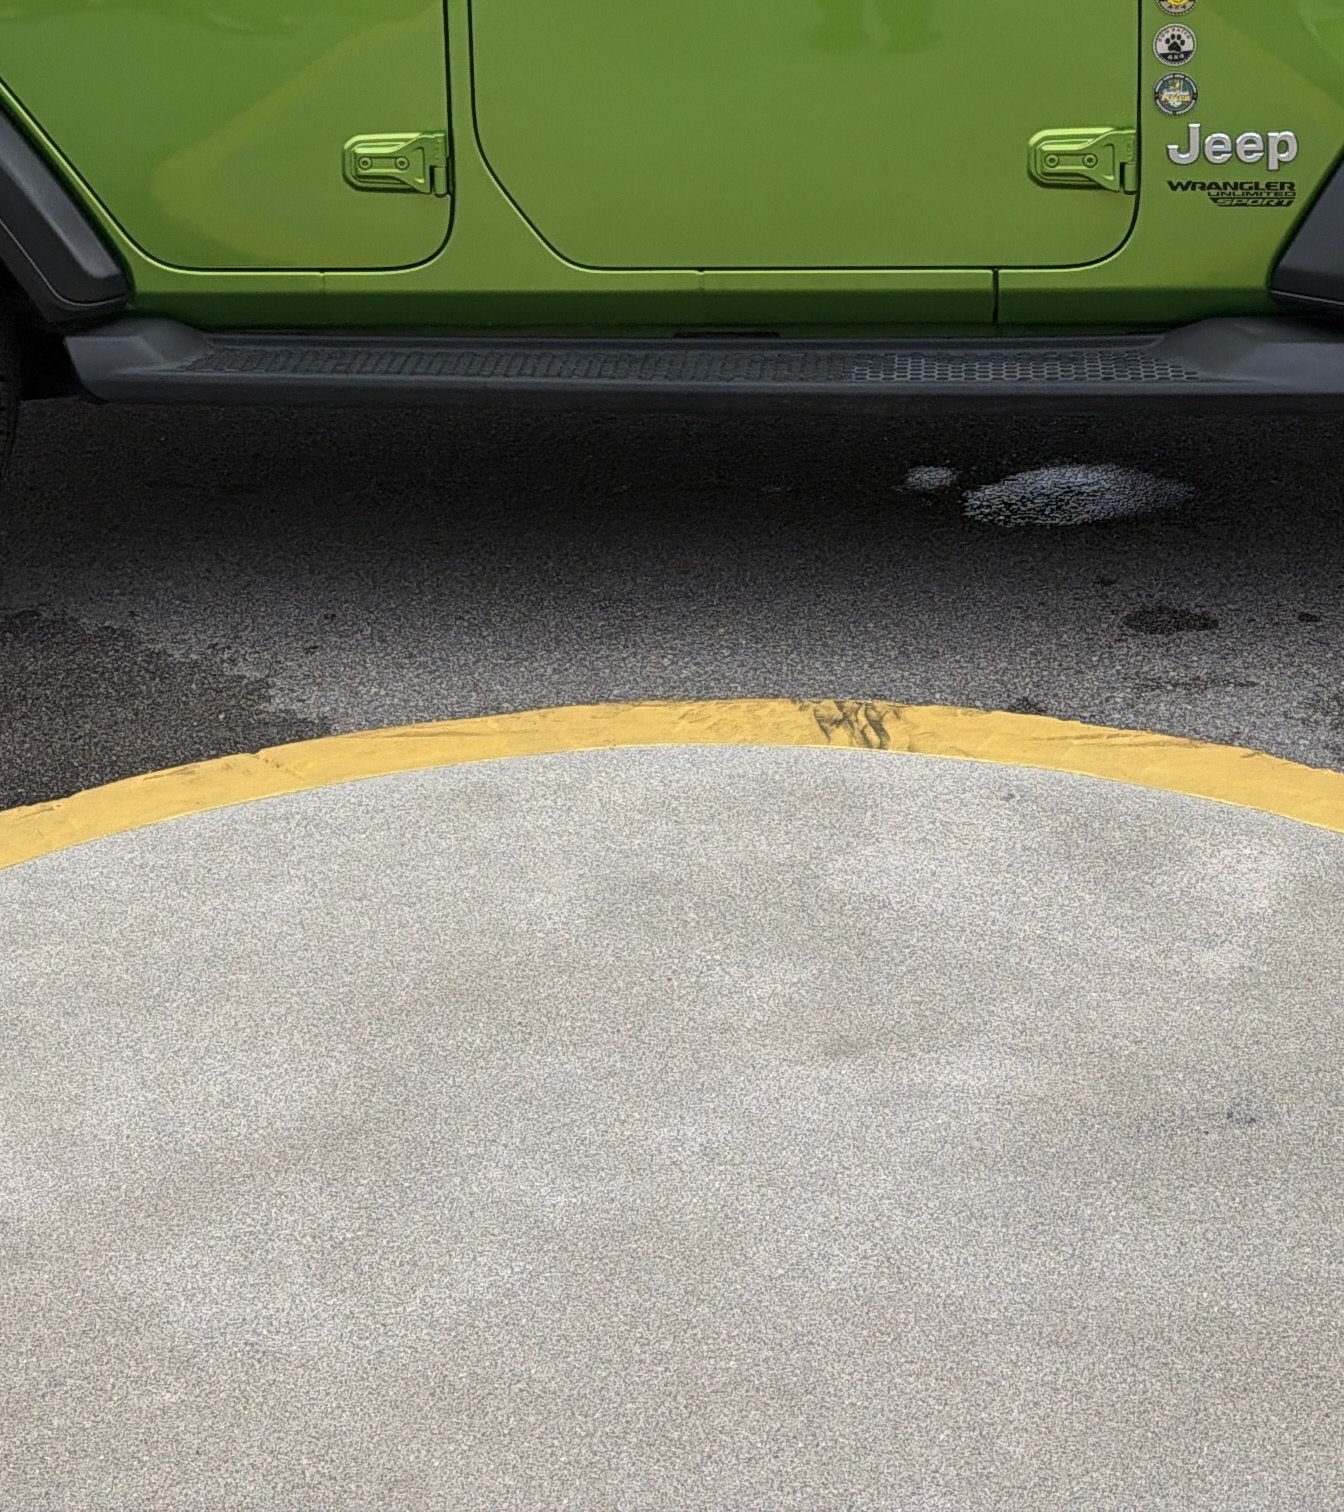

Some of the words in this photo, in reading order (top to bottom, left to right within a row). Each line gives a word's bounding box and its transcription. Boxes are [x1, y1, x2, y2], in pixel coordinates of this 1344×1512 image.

[1167, 123, 1297, 170] Jeep
[1167, 180, 1296, 191] WRANGLER
[1217, 198, 1294, 206] SPORT
